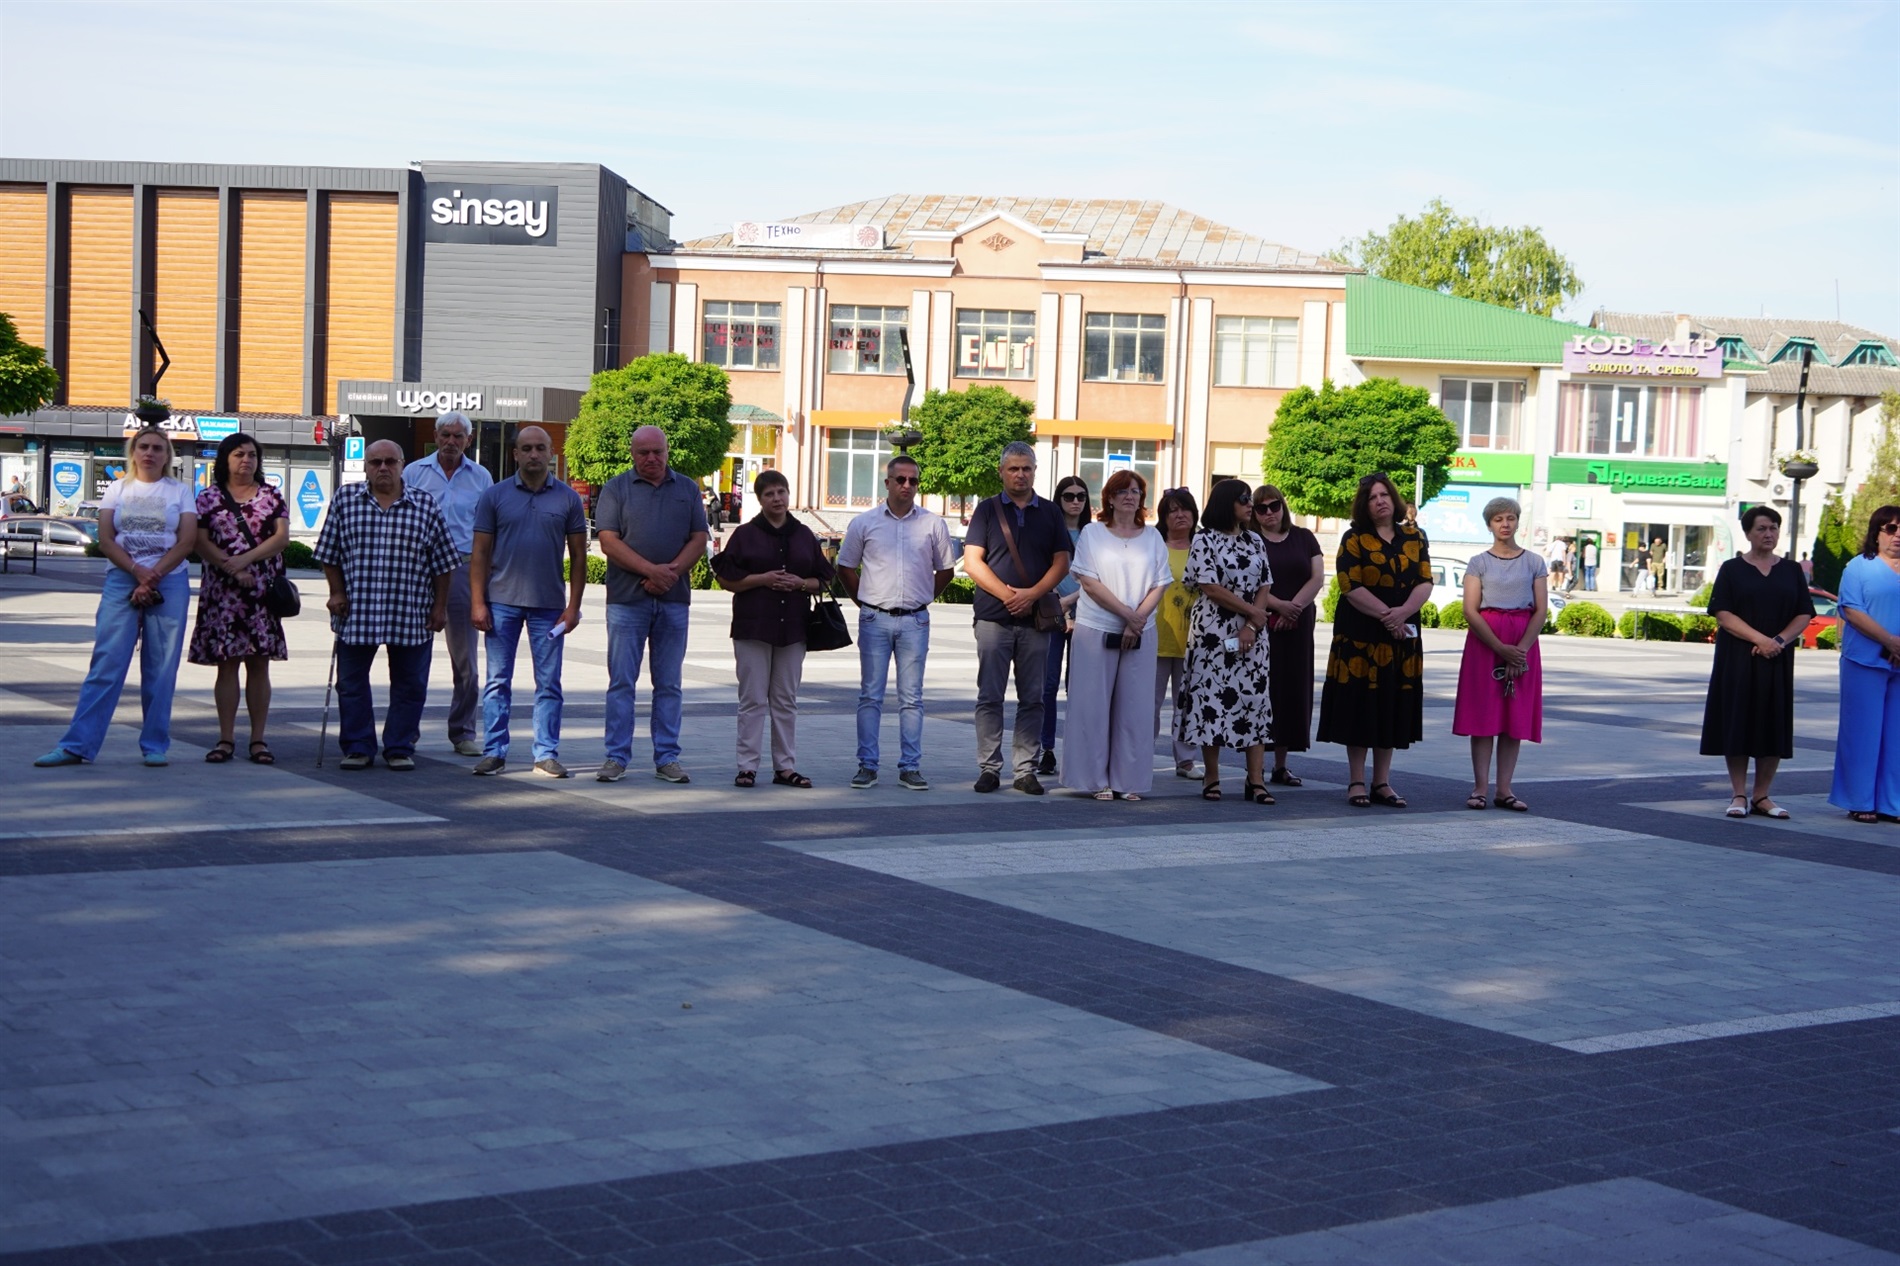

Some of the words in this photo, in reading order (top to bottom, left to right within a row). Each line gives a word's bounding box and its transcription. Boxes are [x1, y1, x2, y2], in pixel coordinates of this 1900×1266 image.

[431, 189, 548, 237] sinsay
[766, 225, 801, 239] ТЕХНО
[1572, 334, 1717, 358] ЮВЕЛІР
[1587, 363, 1633, 373] ЗОЛОТО
[1638, 364, 1651, 374] ТА
[1656, 365, 1699, 376] СРІБЛО
[347, 392, 389, 402] сімейний
[396, 390, 482, 415] щодня
[495, 398, 528, 407] маркет
[349, 439, 360, 458] P
[1609, 470, 1726, 488] ПриватБанк
